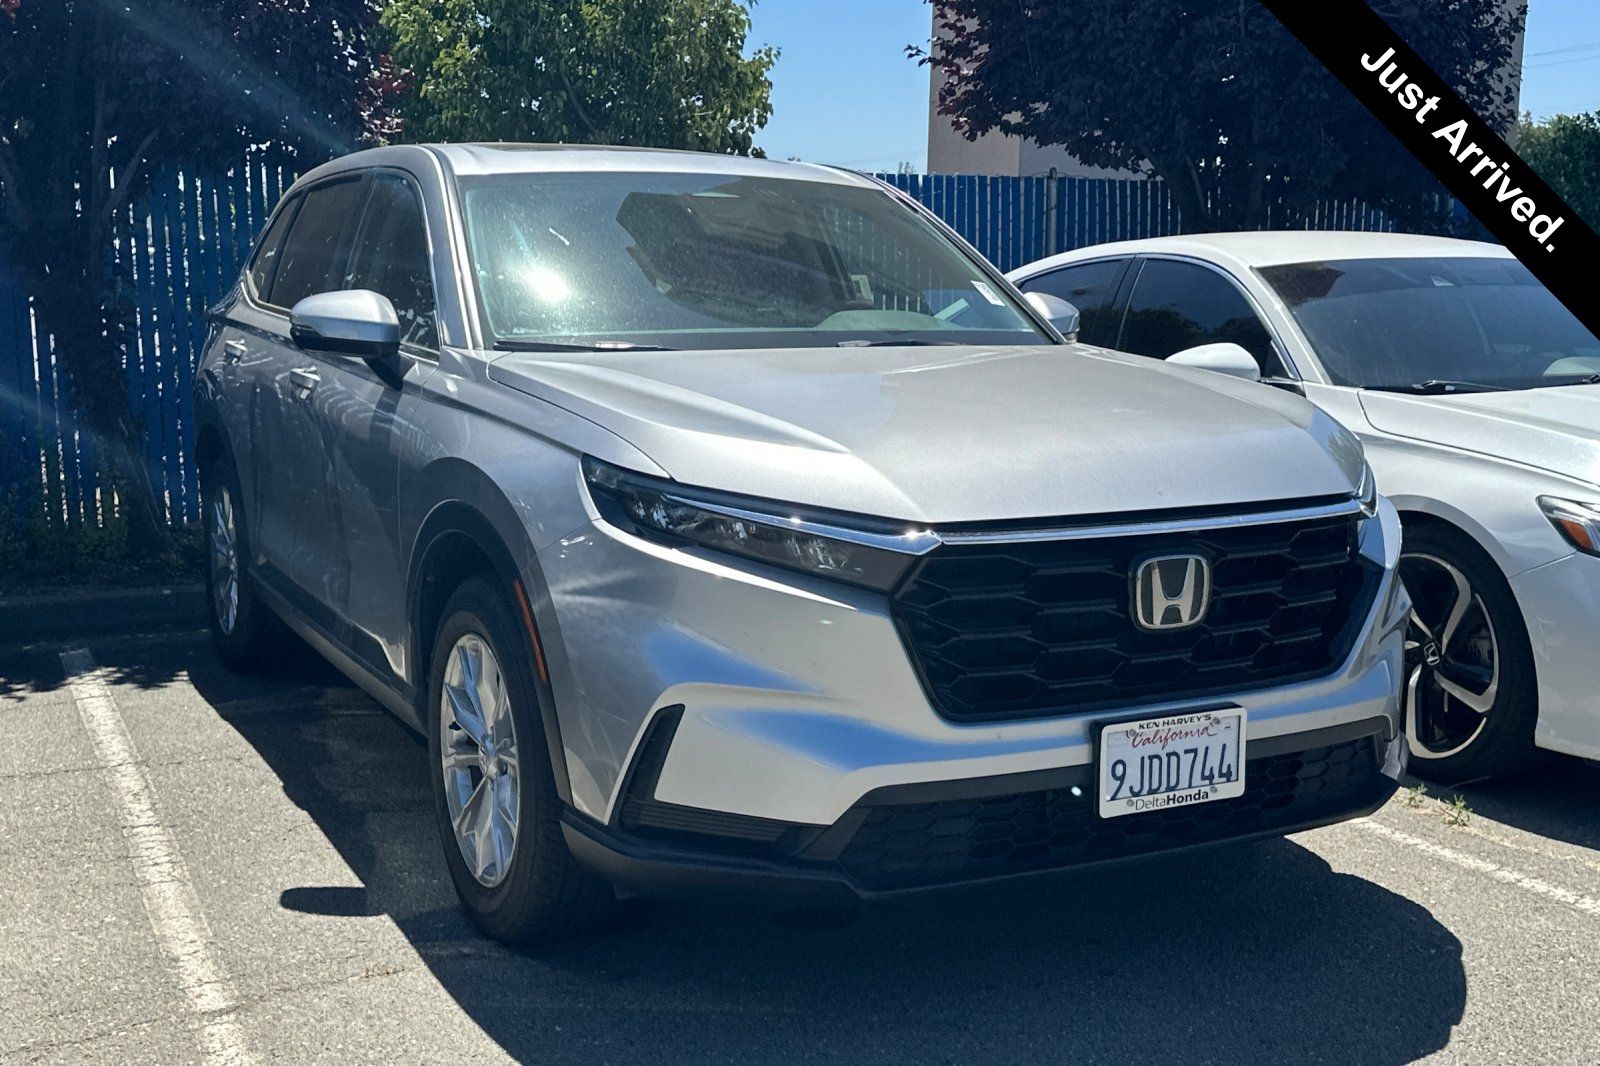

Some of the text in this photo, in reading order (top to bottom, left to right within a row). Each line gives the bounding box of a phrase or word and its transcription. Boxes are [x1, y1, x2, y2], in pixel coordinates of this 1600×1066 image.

[1138, 714, 1212, 730] KEN HARVEY'S
[1131, 724, 1217, 750] California
[1110, 743, 1233, 801] 9JDD744
